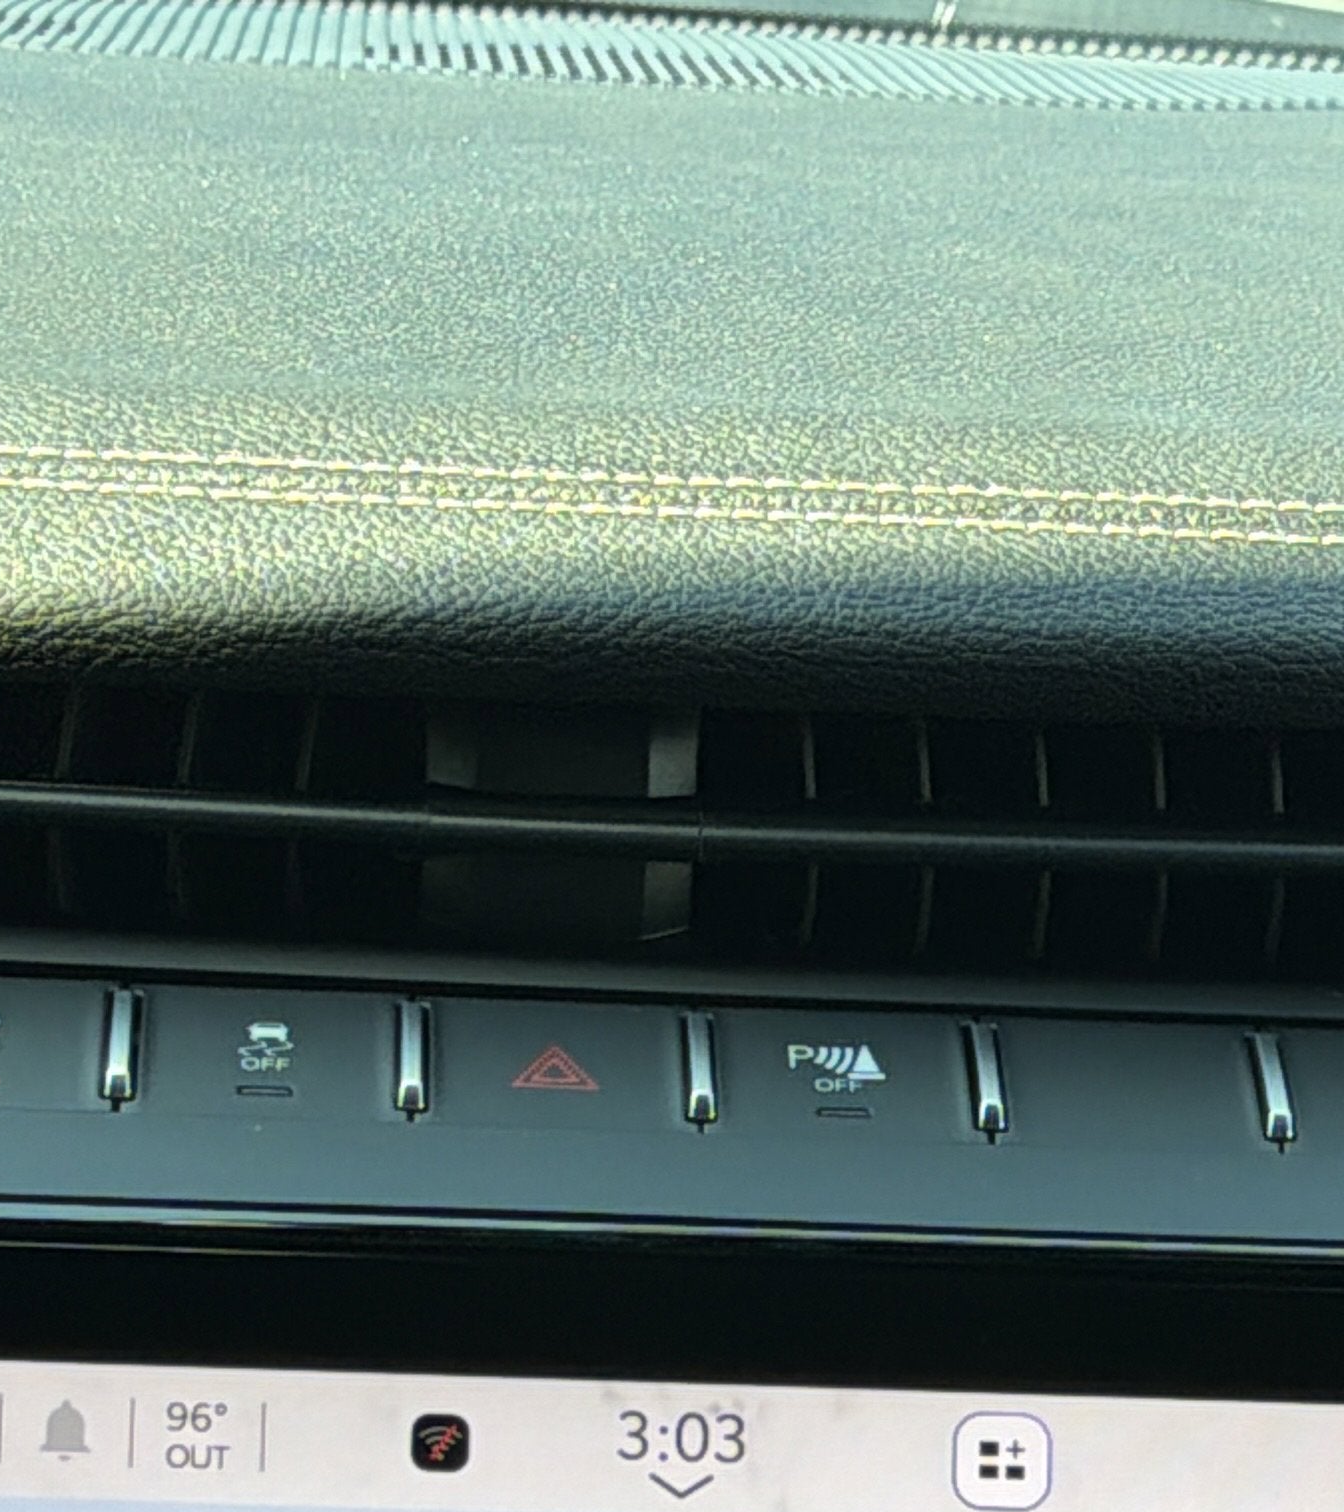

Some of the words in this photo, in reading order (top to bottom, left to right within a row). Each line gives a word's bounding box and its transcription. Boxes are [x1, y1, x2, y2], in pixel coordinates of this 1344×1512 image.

[241, 1057, 290, 1072] OFF
[814, 1078, 862, 1093] OFF
[165, 1402, 229, 1432] 96°
[617, 1411, 747, 1464] 3:03
[167, 1444, 230, 1471] OUT
